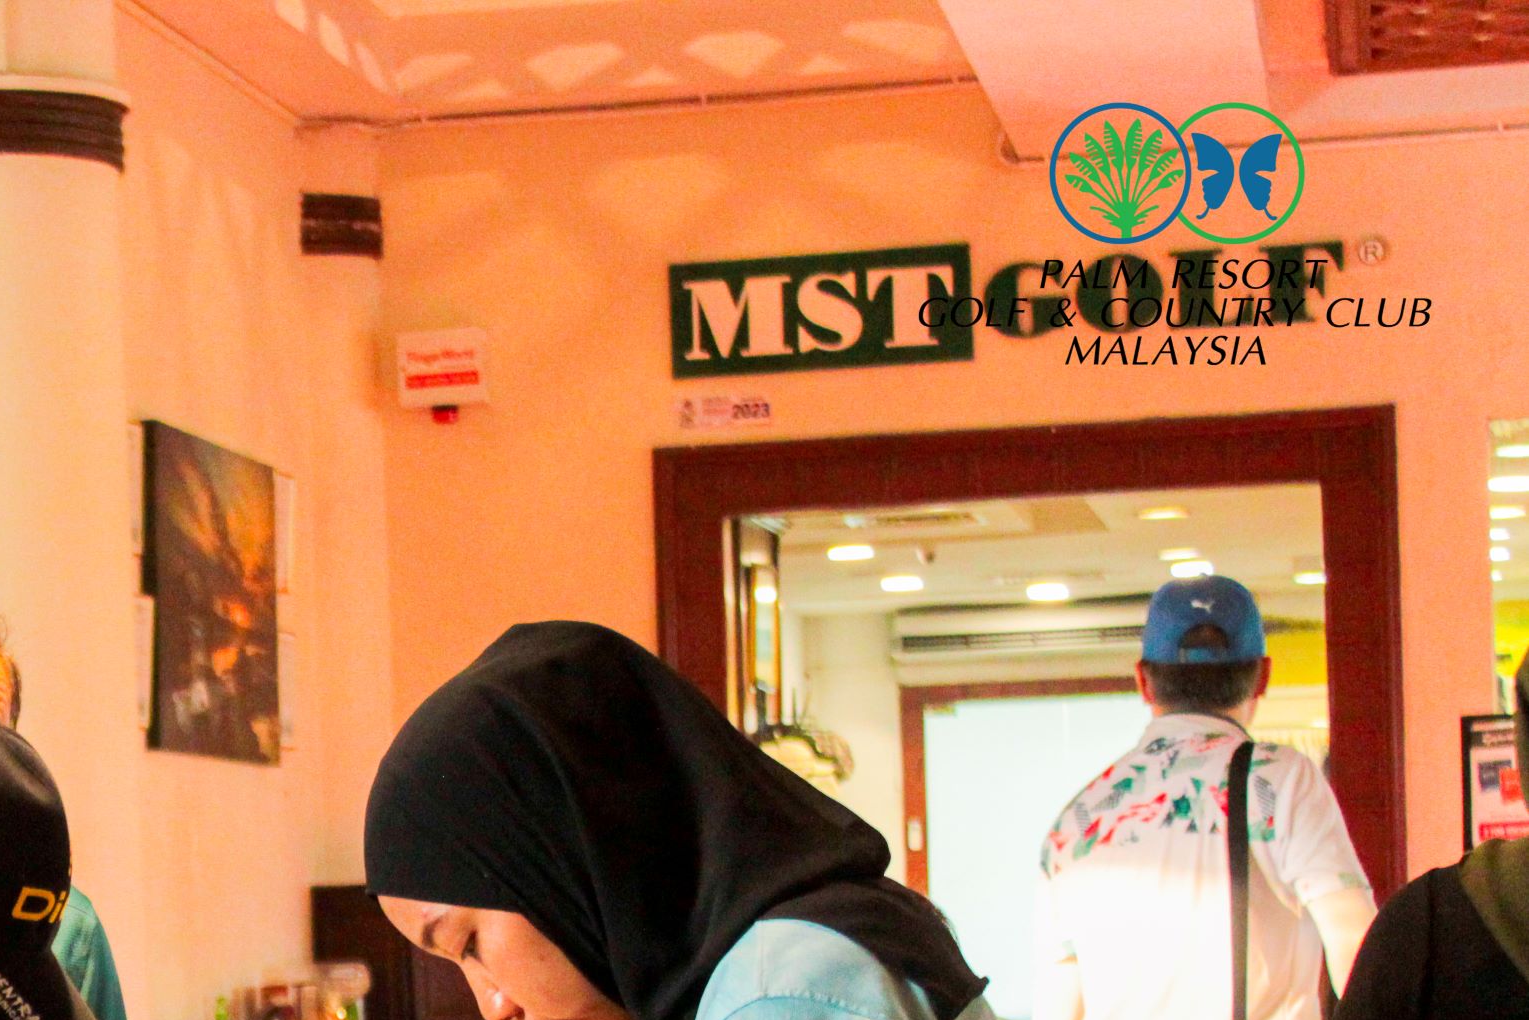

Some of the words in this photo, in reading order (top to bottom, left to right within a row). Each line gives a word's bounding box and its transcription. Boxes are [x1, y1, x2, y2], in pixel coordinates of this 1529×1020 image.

[681, 263, 955, 361] MST
[983, 239, 1344, 338] GOLF
[11, 886, 70, 924] Di
